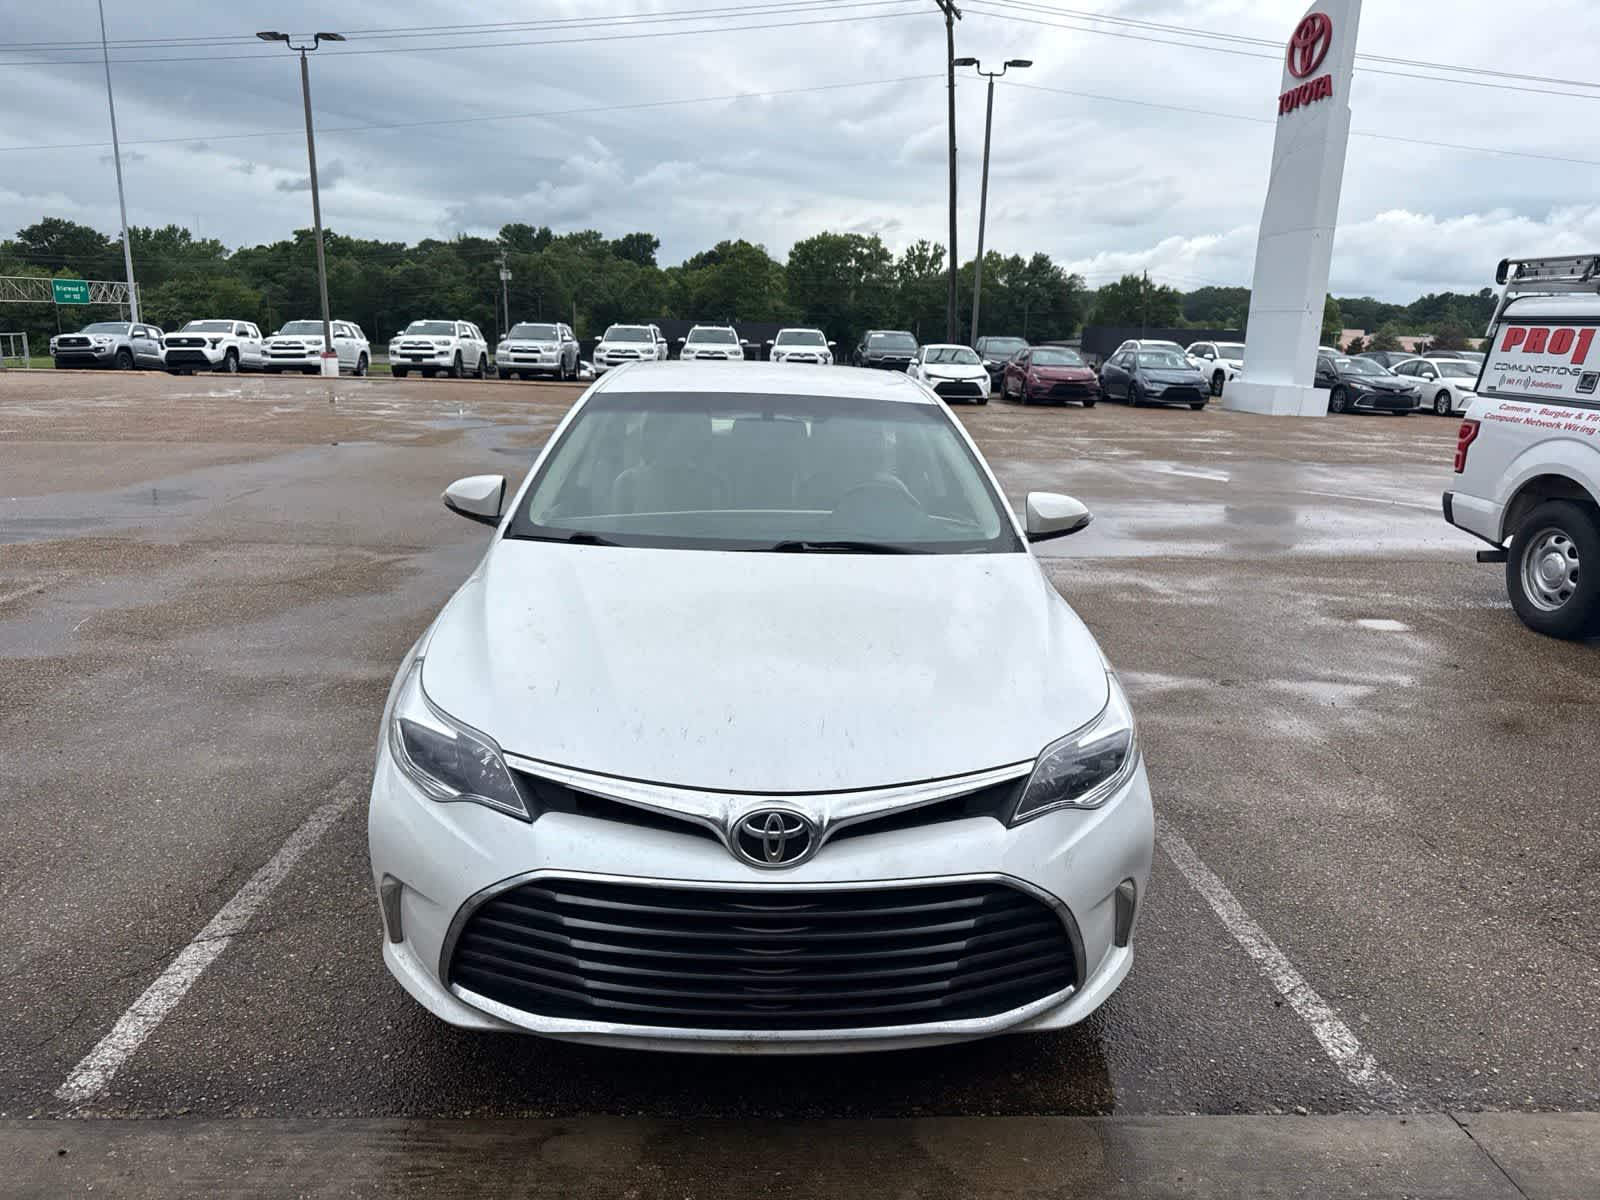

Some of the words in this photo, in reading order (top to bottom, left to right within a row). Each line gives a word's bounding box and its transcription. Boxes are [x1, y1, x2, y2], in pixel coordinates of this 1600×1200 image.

[1278, 74, 1333, 116] TOYOTA
[1501, 327, 1597, 365] PRO1
[1494, 362, 1582, 376] COMMUNICATIONS
[1530, 380, 1563, 389] Solutions
[1499, 403, 1532, 413] Camera
[1539, 408, 1574, 419] Burglar
[1574, 412, 1584, 420] &
[1484, 412, 1523, 423] Computer
[1523, 417, 1562, 430] Network
[1563, 422, 1597, 436] Wiring
